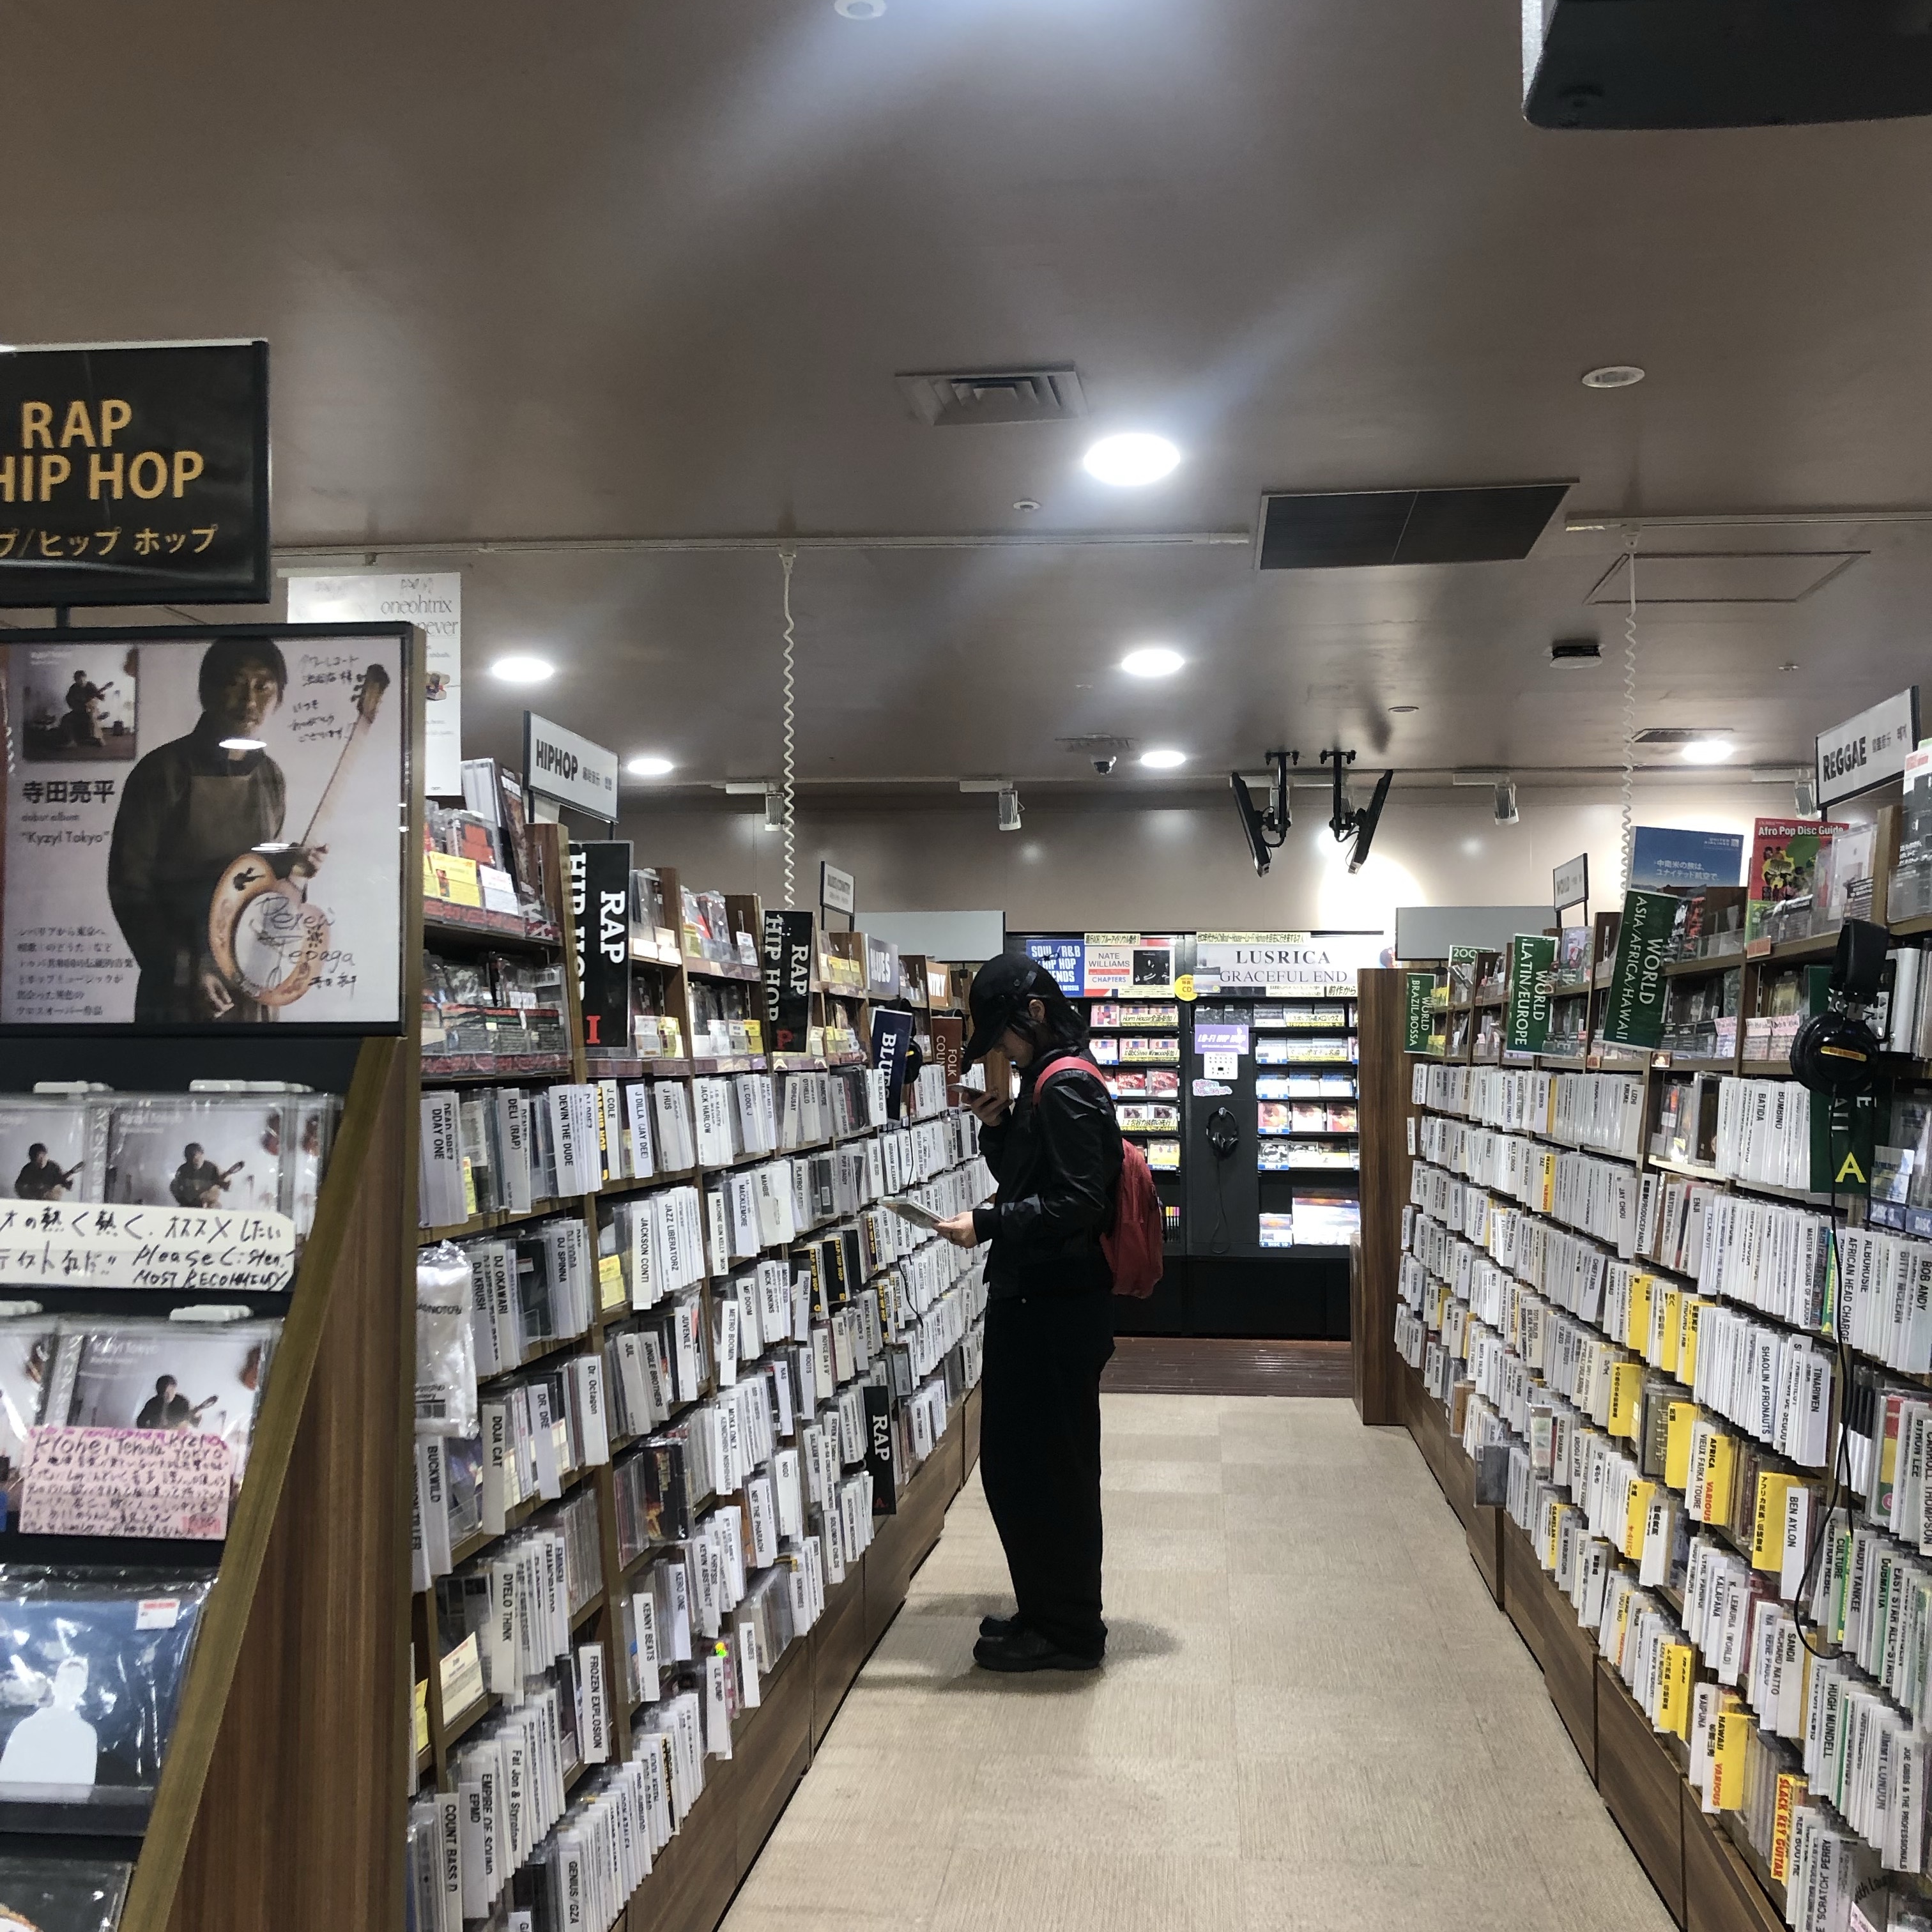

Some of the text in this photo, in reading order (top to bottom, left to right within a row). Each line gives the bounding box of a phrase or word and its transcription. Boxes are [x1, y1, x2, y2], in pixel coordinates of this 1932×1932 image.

[22, 399, 132, 448] RAP
[88, 450, 204, 500] HOP
[134, 523, 218, 556] ホップ
[380, 595, 453, 615] oneohtrix
[536, 739, 578, 781] HIPHOP
[1822, 736, 1867, 783] REGGAE
[22, 779, 116, 804] 寺田亮平
[65, 831, 110, 844] Tokyo"
[1758, 825, 1843, 837] Afro Pop Disc Guide
[600, 891, 625, 964] RAP
[765, 914, 783, 1023] HIP HOP
[790, 944, 809, 997] RAP
[1059, 958, 1076, 969] HOP
[1220, 970, 1347, 983] GRACEFUL END
[1236, 951, 1331, 964] LUSRICA
[1615, 896, 1648, 1041] ASIA/AFRICA/HAWAII
[1639, 938, 1663, 1005] WORLD
[1409, 979, 1420, 1047] BRAZIL/BOSSA
[1420, 997, 1430, 1032] WORLD
[1514, 938, 1534, 1047] LATIN/EUROPE
[1534, 970, 1553, 1022] WORLD
[947, 1048, 957, 1077] FOLK
[508, 1098, 521, 1150] DELI (RAP)
[607, 1098, 615, 1119] COLE
[635, 1097, 645, 1119] DILLA
[701, 1085, 711, 1133] JACK HARLOW
[1756, 1093, 1766, 1121] BATIDA
[1775, 1092, 1785, 1130] BOMBINO
[432, 1108, 445, 1160] DDAY ONE
[559, 1094, 573, 1167] DEVIN THE DUDE
[1835, 1152, 1867, 1183] A
[739, 1184, 747, 1227] MACKLEMORE
[557, 1237, 567, 1283] DJ SPINNA
[641, 1218, 649, 1256] JACKSON
[664, 1203, 679, 1271] JAZZ LIBERATORZ
[132, 1269, 178, 1287] MOST
[473, 1276, 486, 1310] KRUSH
[494, 1255, 508, 1314] DJ OKAWARI
[1589, 1259, 1599, 1290] CHIEFTAINS
[1841, 1237, 1857, 1342] AFRICAN HEAD CHARGE
[1917, 1260, 1931, 1311] BOB ANDY
[744, 1295, 753, 1315] DOOM
[765, 1288, 775, 1314] JENKINS
[625, 1343, 634, 1358] JUL
[682, 1314, 691, 1350] JUVENILE
[588, 1365, 597, 1415] Dr. Octagon
[644, 1342, 663, 1407] JUNGLE BROTHERS
[1761, 1346, 1771, 1434] SHAOLIN AFRONAUTS
[1811, 1368, 1823, 1413] TINARIWEN
[492, 1416, 503, 1468] DOJA CAT
[872, 1414, 890, 1461] RAP
[427, 1445, 441, 1503] BUCKWILD
[1696, 1457, 1706, 1485] FARKA
[1703, 1438, 1717, 1521] AFRICA VARIOUS
[1693, 1486, 1703, 1510] TOURE
[1787, 1496, 1798, 1548] BEN AYLON
[1834, 1538, 1845, 1579] CULTURE
[1712, 1575, 1725, 1618] KALAPANA
[1850, 1577, 1861, 1613] YANKEE
[643, 1602, 655, 1661] KENNY BEATS
[1723, 1594, 1739, 1666] LEMURIA (WORLD)
[1786, 1633, 1797, 1662] SANDII
[589, 1655, 603, 1749] FROZEN EXPLOSION
[1697, 1694, 1708, 1729] WAIPUNA
[1823, 1683, 1837, 1759] HUGH MUNDELL
[1712, 1716, 1725, 1806] HAWAII VARIOUS
[445, 1804, 457, 1843] COUNT
[1774, 1777, 1790, 1878] SLACK KEY GUITAR
[1899, 1811, 1910, 1869] PROFESSIONALS
[484, 1836, 493, 1875] SOUND
[1816, 1839, 1832, 1920] "SCRATCH" PERRY
